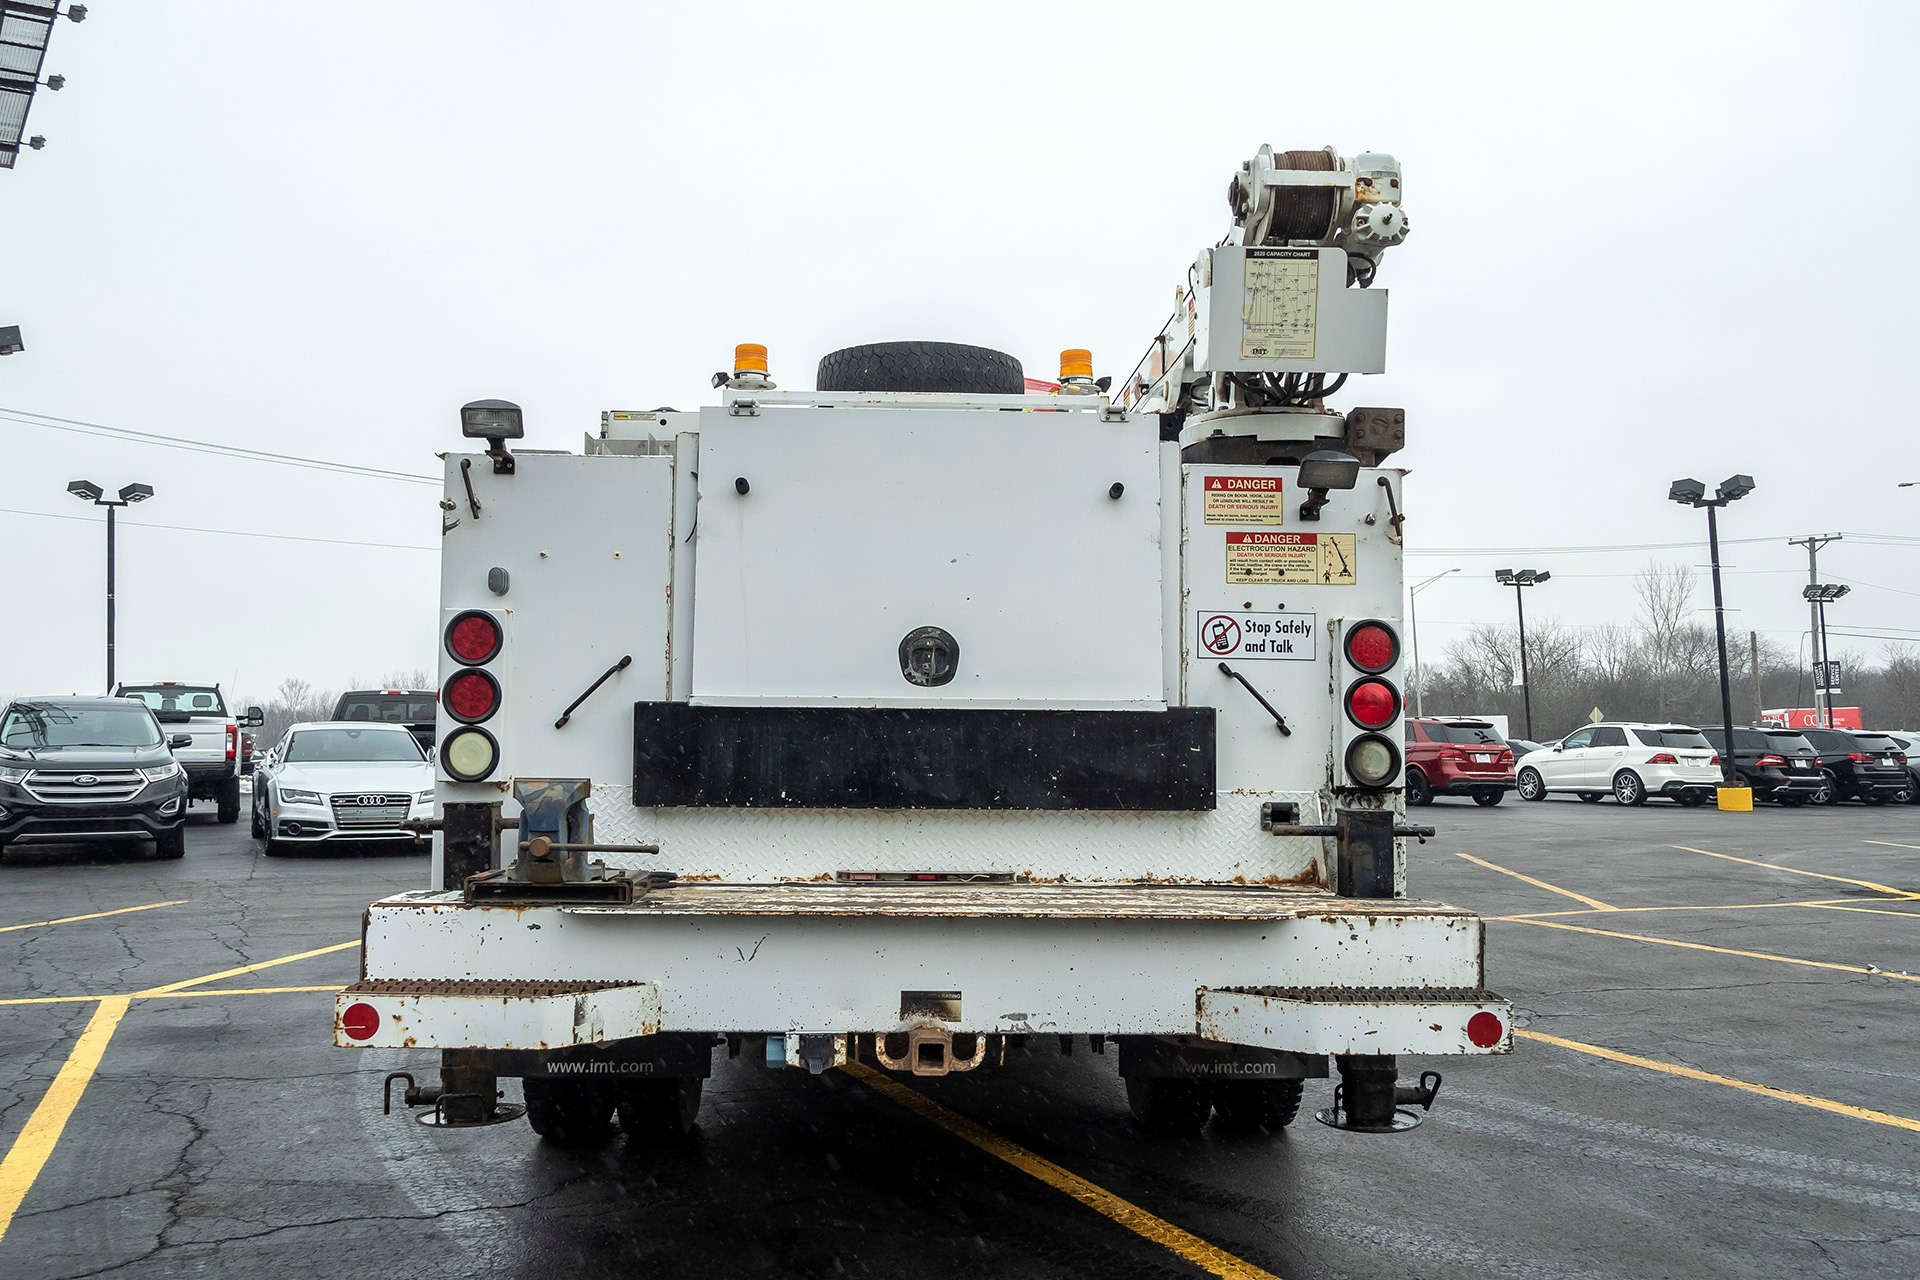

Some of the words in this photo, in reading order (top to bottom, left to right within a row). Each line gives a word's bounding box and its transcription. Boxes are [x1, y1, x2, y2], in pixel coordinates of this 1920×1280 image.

[1228, 479, 1276, 489] DANGER
[1254, 535, 1301, 544] DANGER
[1245, 620, 1271, 637] Stop
[1275, 620, 1312, 638] Safely
[1245, 639, 1265, 652] and
[1270, 639, 1294, 653] Talk
[547, 1059, 654, 1074] www.imt.com
[1172, 1060, 1276, 1074] www.imt.com
